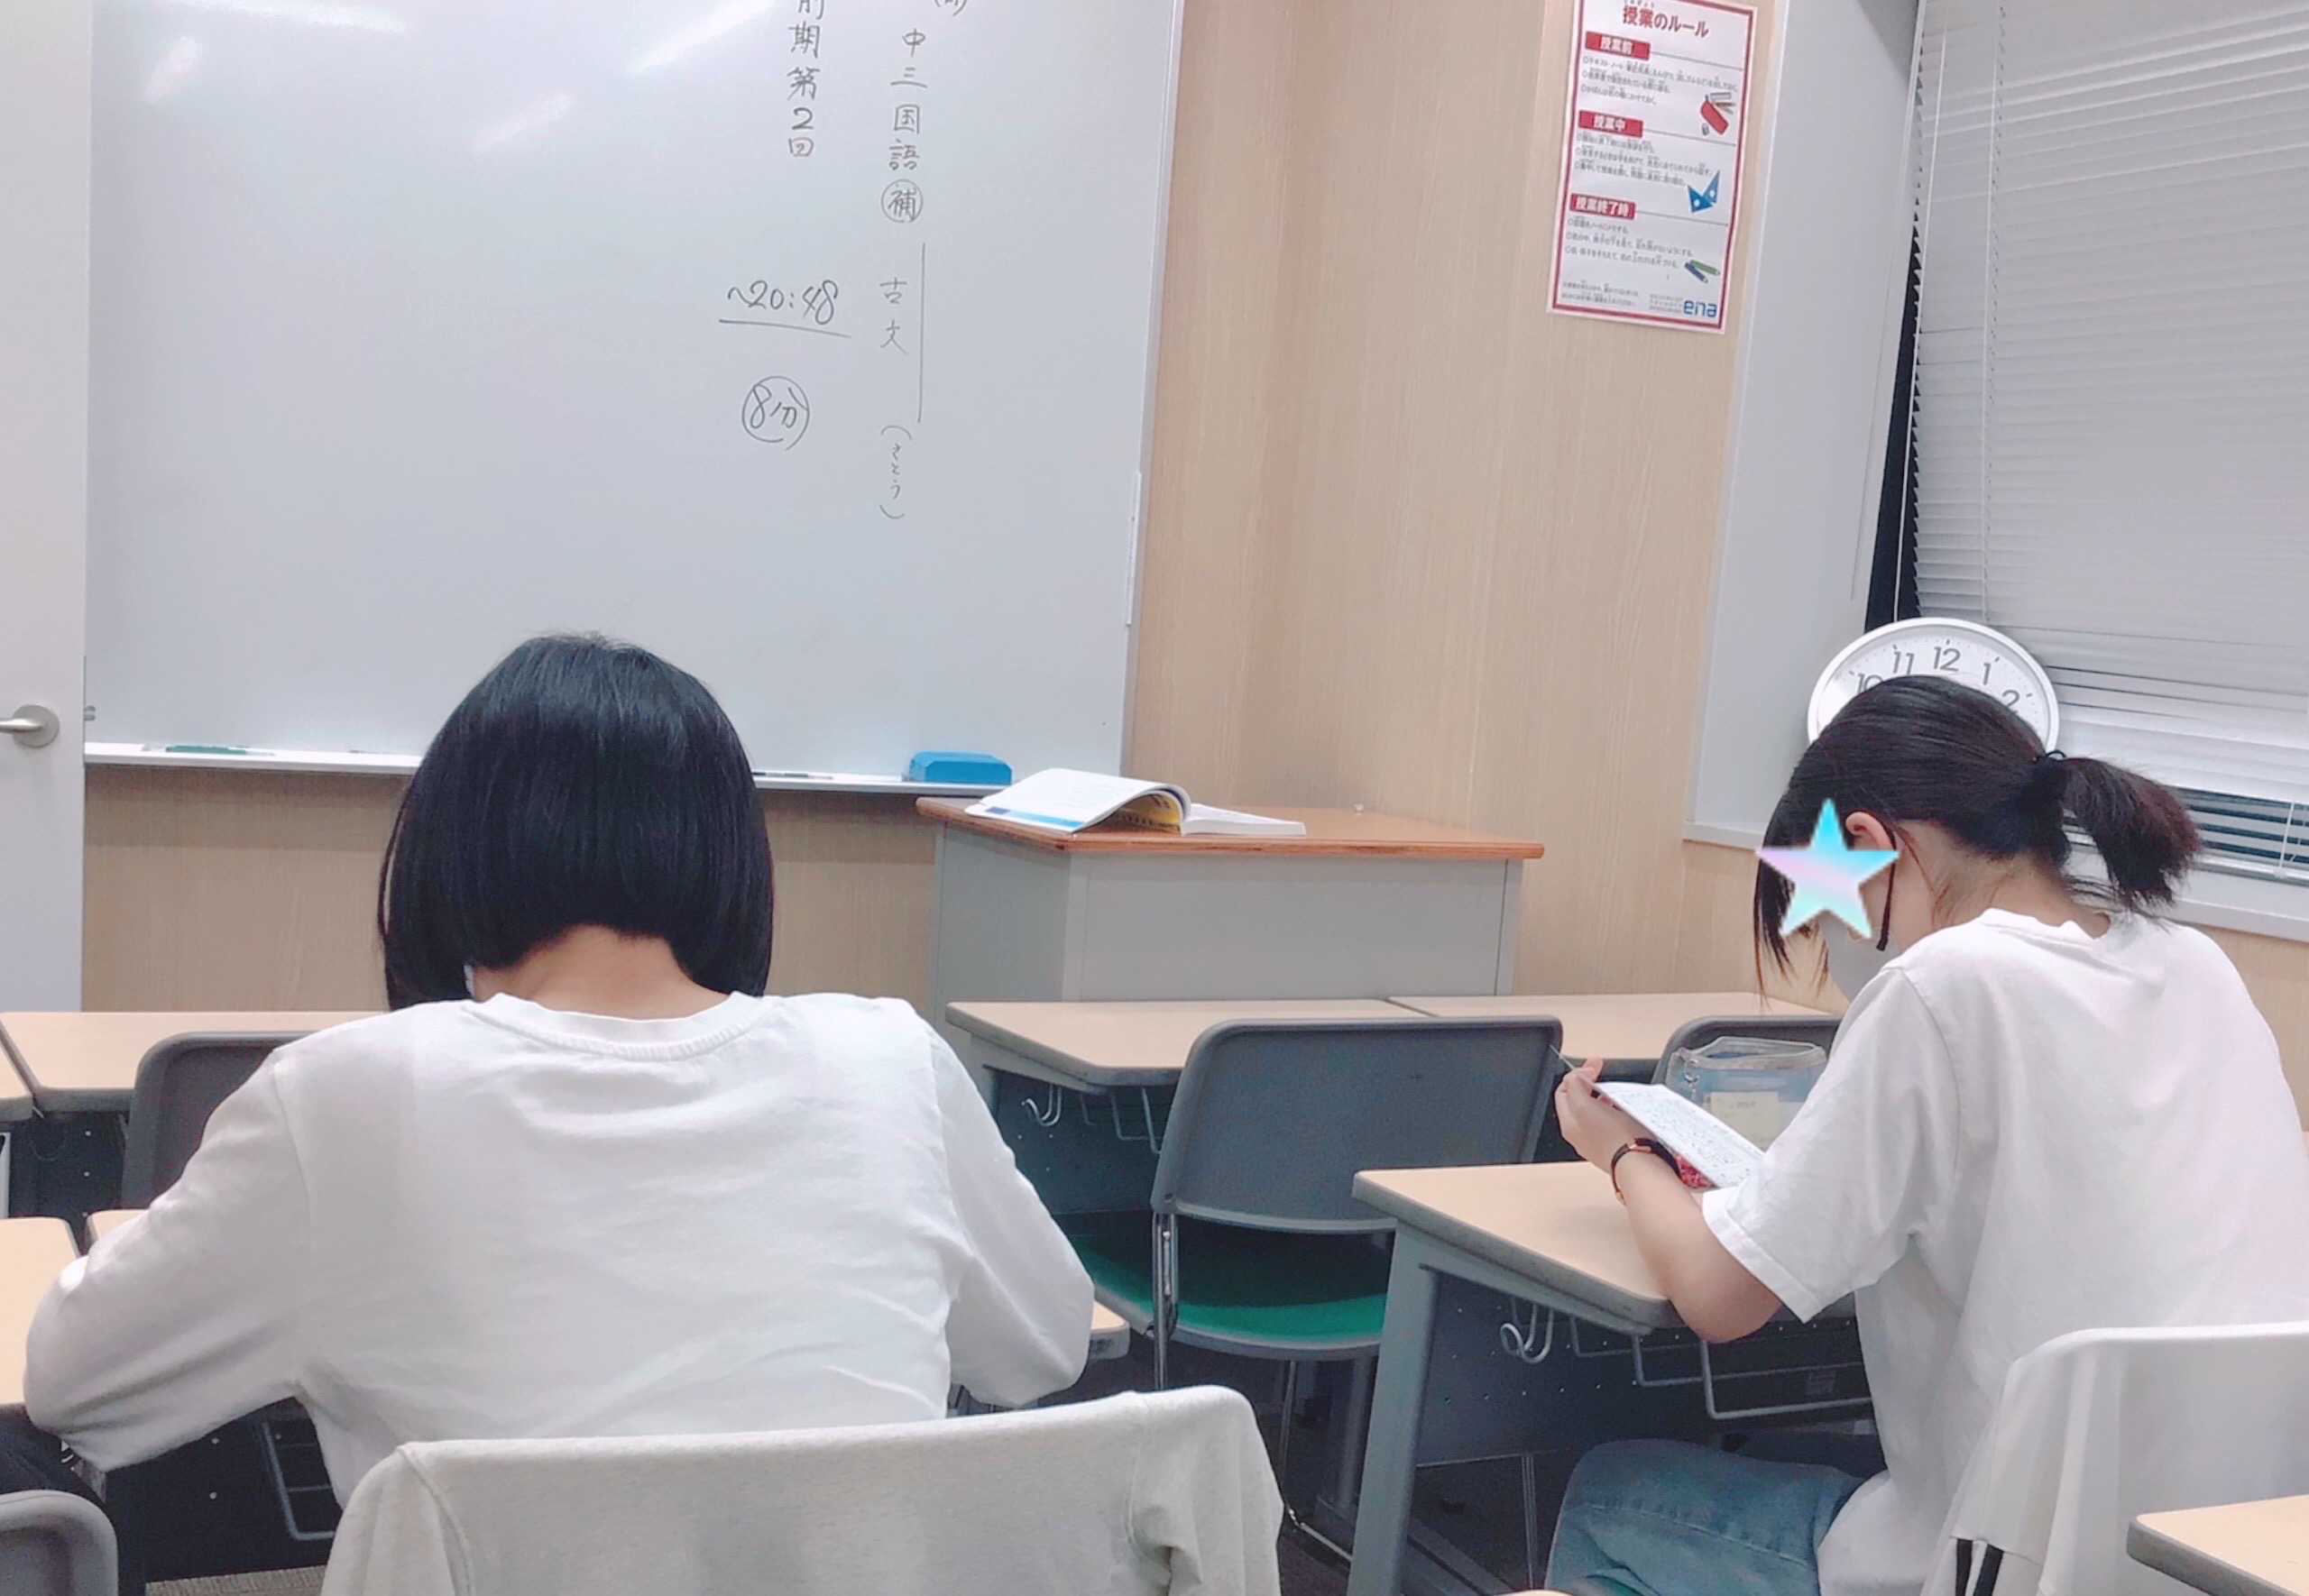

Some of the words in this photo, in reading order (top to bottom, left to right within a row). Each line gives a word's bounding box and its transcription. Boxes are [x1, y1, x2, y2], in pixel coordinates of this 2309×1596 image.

[1623, 5, 1709, 38] 授業のルール
[1601, 36, 1633, 56] 授業前
[1593, 114, 1626, 132] 授業中
[1576, 196, 1630, 217] 授業終了時
[879, 277, 908, 355] 古文
[1683, 299, 1717, 317] ena
[747, 380, 809, 431] 8分
[1892, 650, 1916, 674] 11
[1932, 646, 1962, 673] 12
[1982, 661, 1992, 686] 1
[2001, 689, 2020, 713] 2
